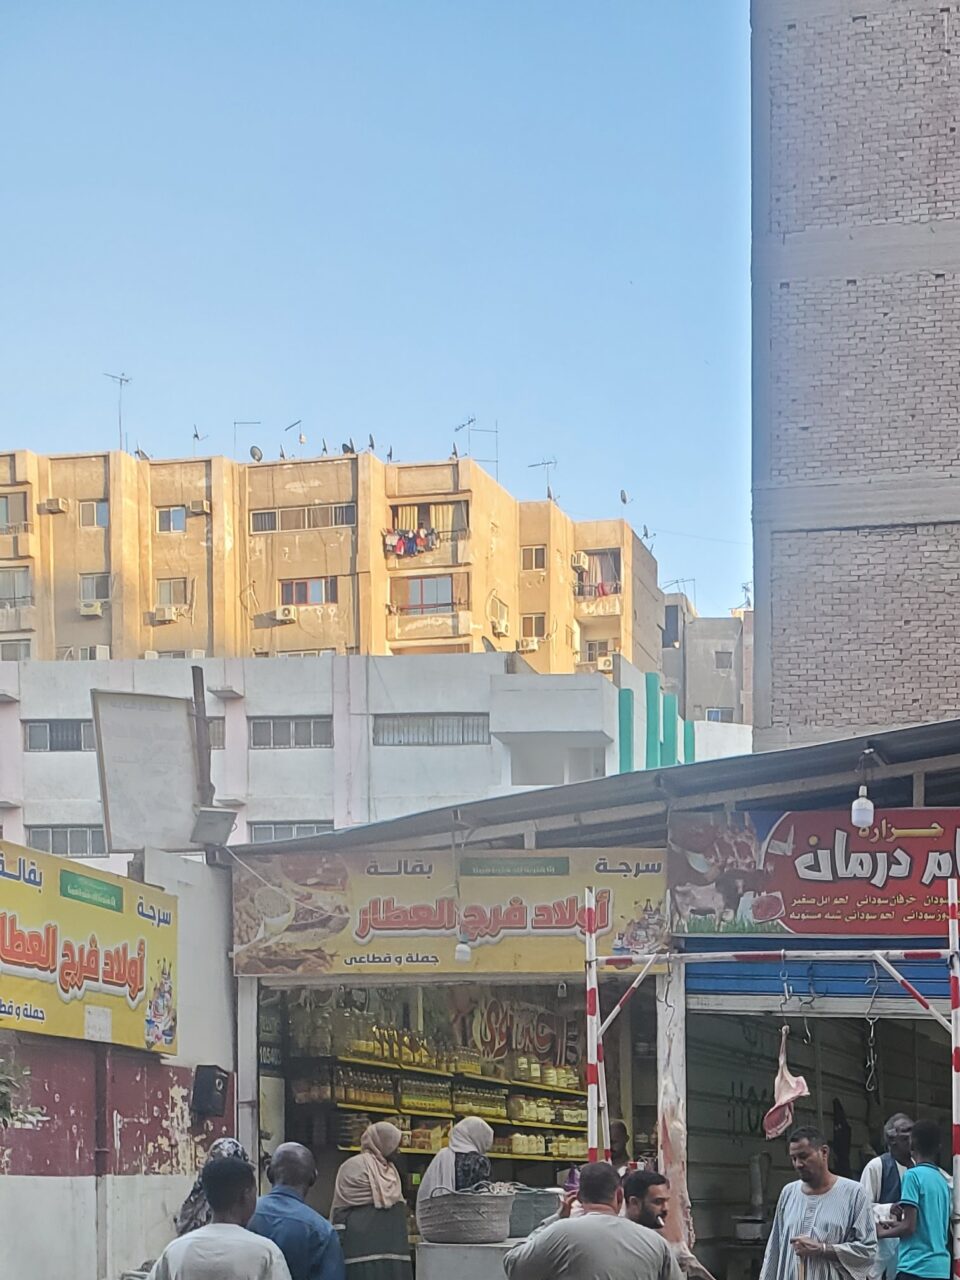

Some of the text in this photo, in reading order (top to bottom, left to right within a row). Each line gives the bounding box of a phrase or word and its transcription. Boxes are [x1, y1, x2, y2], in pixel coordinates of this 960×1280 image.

[366, 859, 433, 879] بقالة
[594, 856, 663, 879] سرجة
[794, 829, 911, 887] درمان
[137, 896, 172, 927] سرجة
[355, 897, 457, 939] العطار
[459, 897, 528, 941] فرج
[0, 912, 145, 999] أولاد فرج العطا
[343, 951, 440, 966] جملة و قطاعى
[15, 1005, 21, 1020] و
[22, 1003, 45, 1024] جملة
